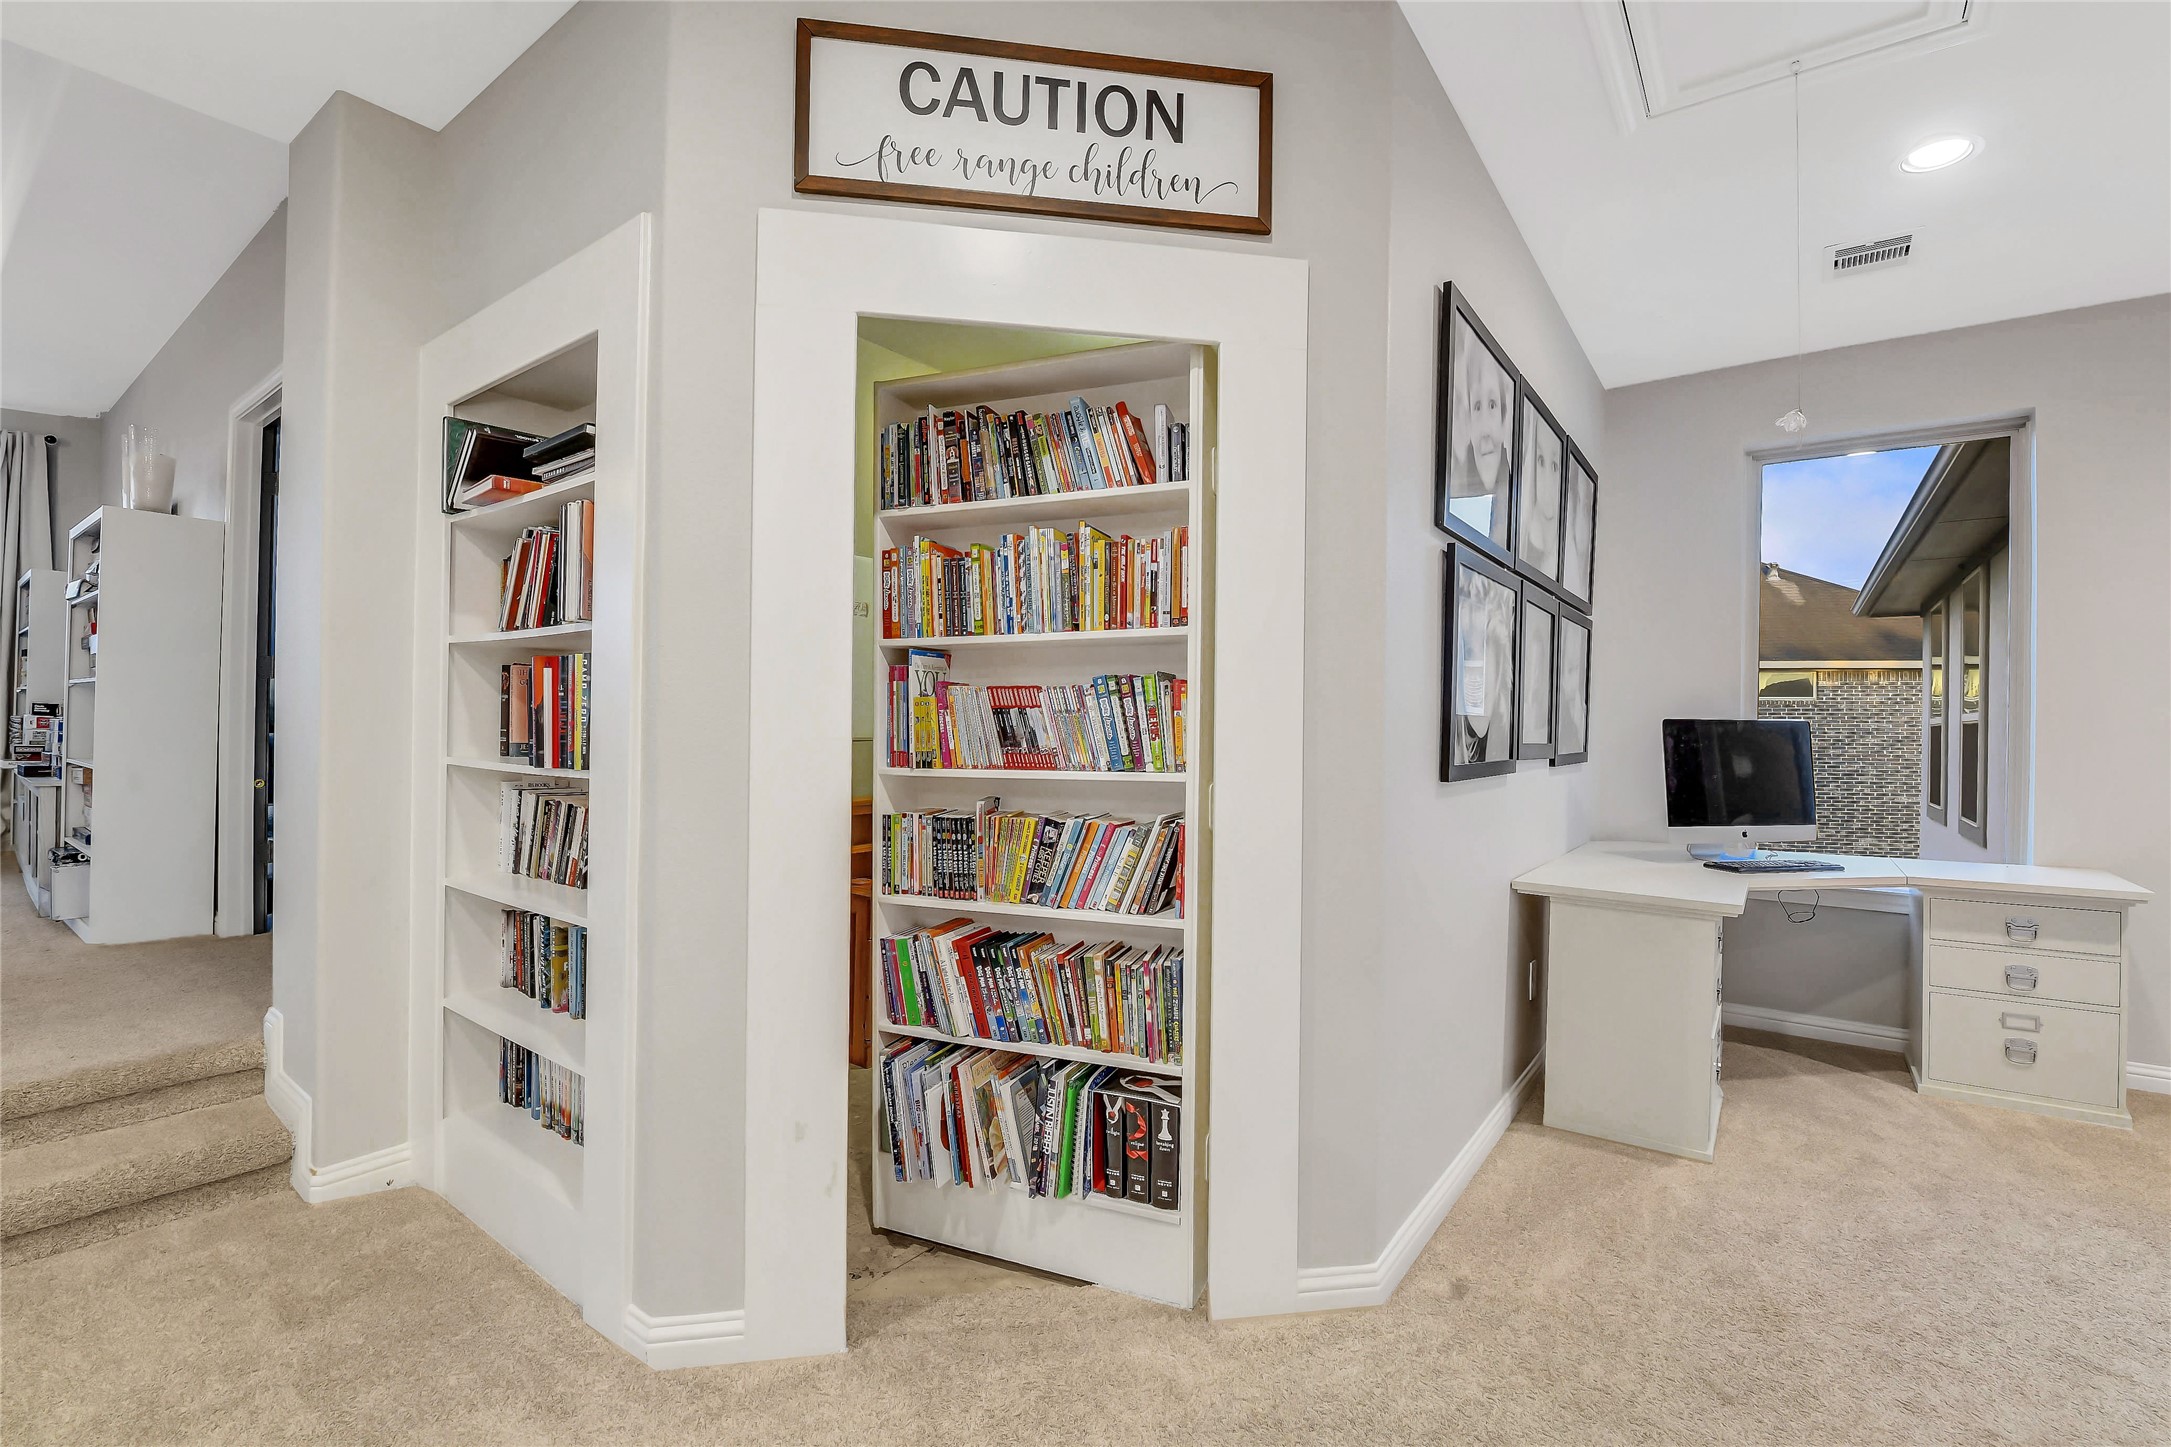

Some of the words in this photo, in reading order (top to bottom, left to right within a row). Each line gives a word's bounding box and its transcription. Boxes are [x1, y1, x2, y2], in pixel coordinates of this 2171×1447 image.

[899, 61, 1184, 144] CAUTION
[836, 134, 943, 182] free
[953, 148, 1058, 196] range
[1068, 142, 1238, 203] children
[1038, 847, 1053, 884] KEEPER
[1031, 863, 1041, 883] CITIES
[994, 966, 1002, 978] DOG
[1006, 966, 1014, 978] DOG
[978, 977, 986, 987] MAN
[986, 978, 994, 988] MAN
[997, 979, 1005, 989] MAN
[1008, 978, 1016, 988] MAN
[1018, 979, 1026, 990] MAN
[1025, 980, 1034, 990] MAN
[1045, 1084, 1056, 1119] JUSTIN
[1042, 1121, 1052, 1154] BIEBER
